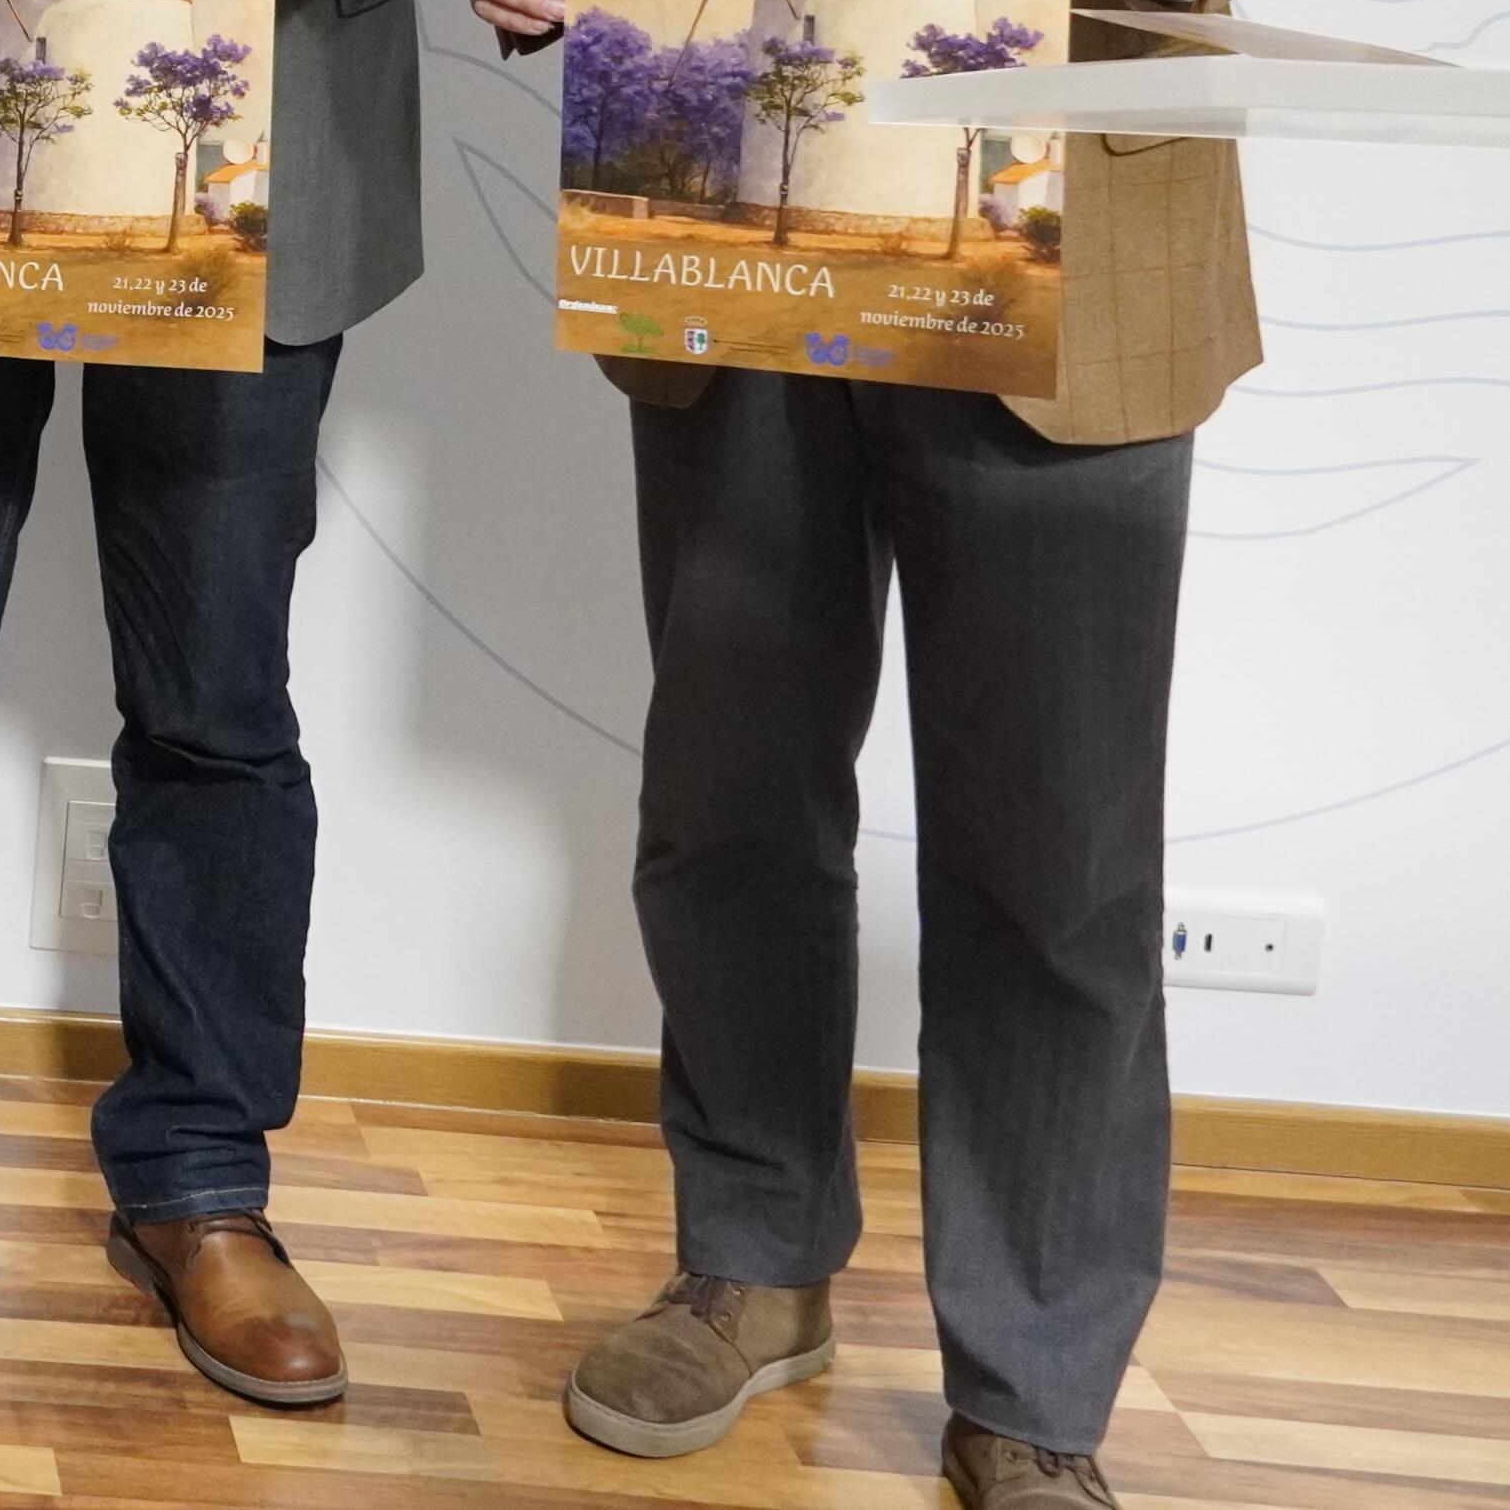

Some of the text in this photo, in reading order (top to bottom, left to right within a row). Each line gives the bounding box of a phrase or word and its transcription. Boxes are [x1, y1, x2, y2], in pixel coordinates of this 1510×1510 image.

[569, 244, 836, 299] VILLABLANCA
[156, 280, 165, 295] y
[168, 279, 186, 293] 23
[189, 277, 207, 292] de
[935, 290, 946, 307] y
[950, 290, 970, 306] 23
[973, 289, 994, 306] de
[87, 300, 234, 321] noviembre de 2025
[860, 310, 1024, 340] noviembre de 2025
